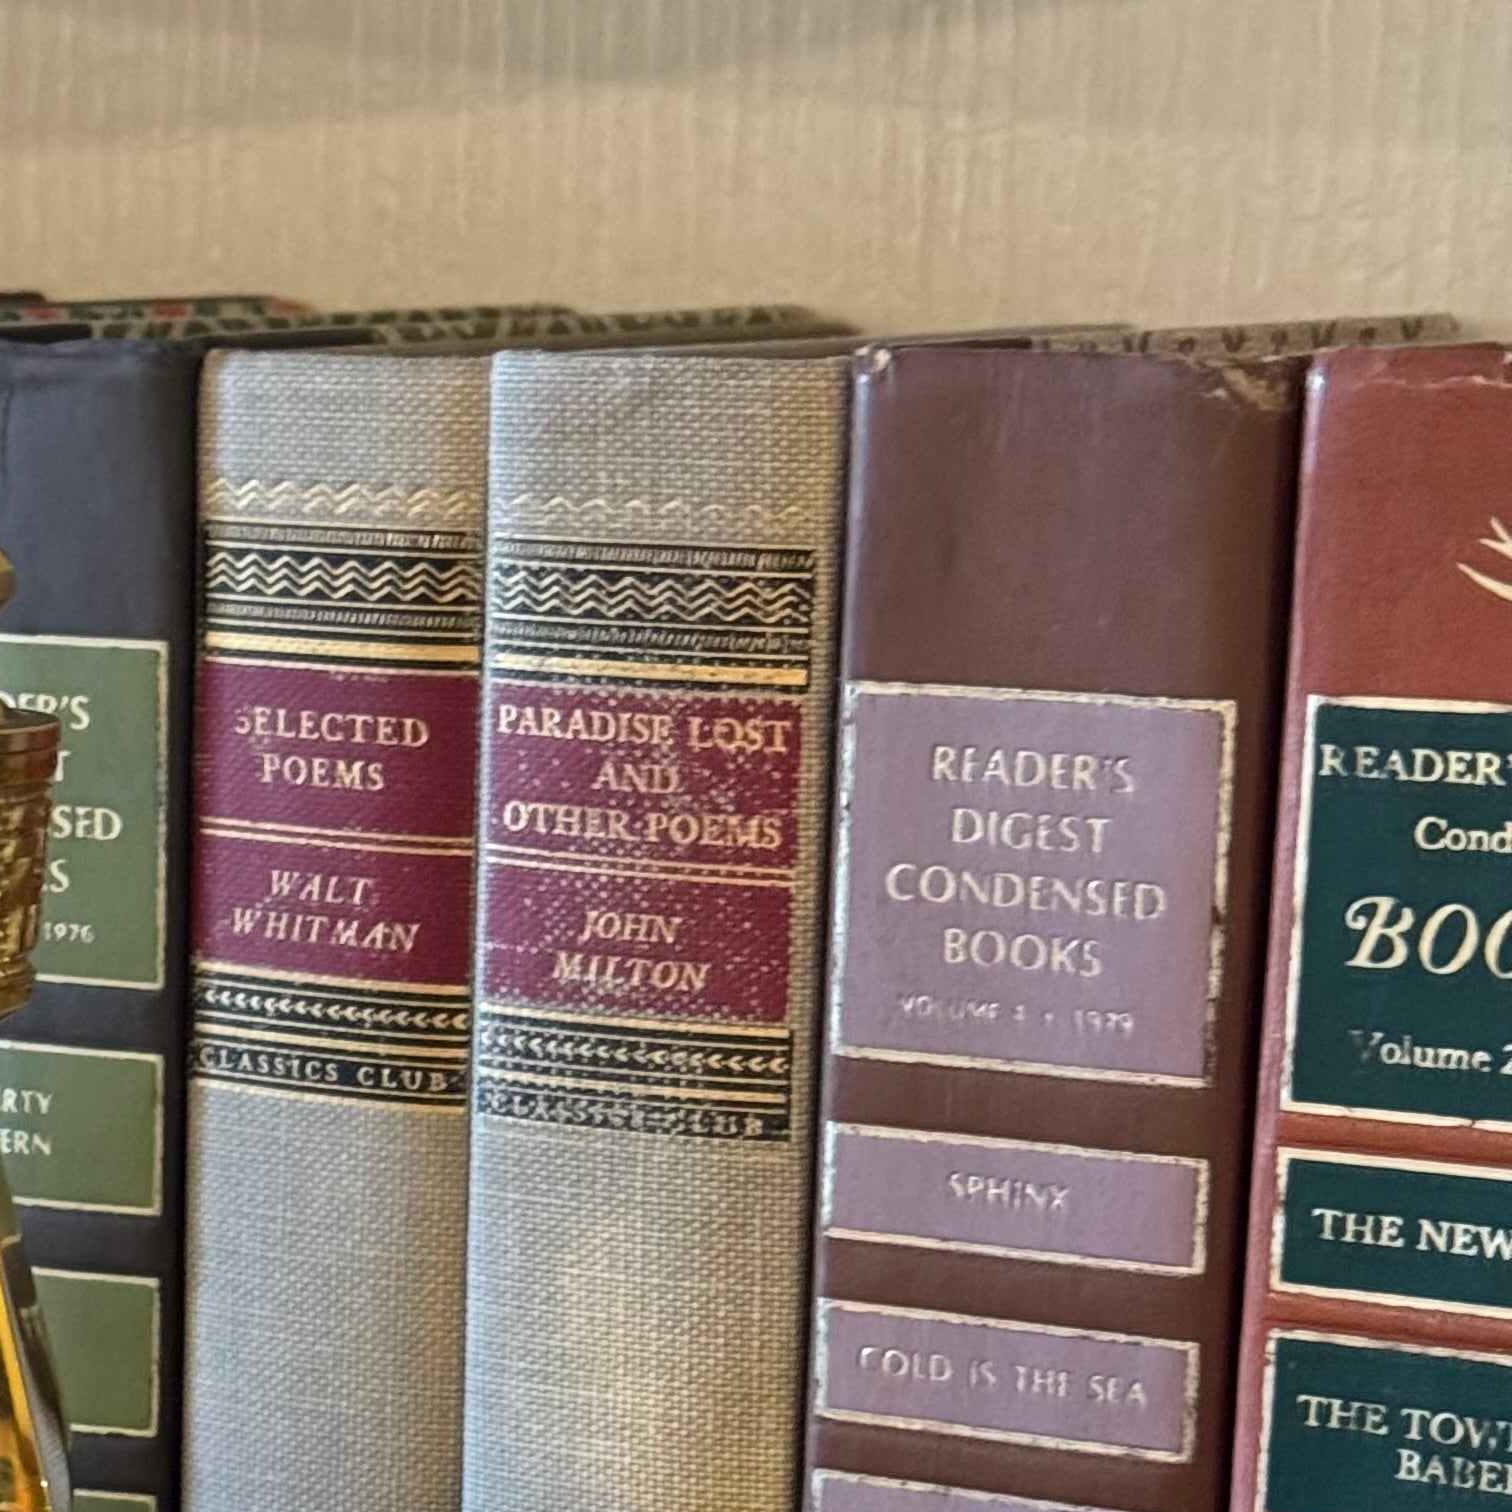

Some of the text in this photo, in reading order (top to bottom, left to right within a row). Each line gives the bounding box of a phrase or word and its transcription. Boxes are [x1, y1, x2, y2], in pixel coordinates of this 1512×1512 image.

[235, 706, 430, 750] SELECTED
[498, 703, 791, 753] PARADISE LOST
[261, 753, 385, 792] POEMS
[591, 763, 680, 796] AND
[931, 745, 1135, 794] READER'S
[502, 800, 785, 850] OTHER POEMS
[951, 808, 1112, 853] DIGEST
[270, 868, 374, 906] WALT
[885, 863, 1168, 921] CONDENSED
[42, 921, 95, 945] 1976
[231, 908, 421, 953] WHITMAN
[582, 910, 684, 944] JOHN
[554, 952, 712, 992] MILTON
[943, 928, 1103, 977] BOOKS
[199, 1047, 448, 1092] CLASSICS CLUB
[1348, 1030, 1492, 1072] Volume
[948, 1171, 1069, 1211] SPHINX
[1311, 1208, 1405, 1249] THE
[859, 1347, 1148, 1408] COLD IS THE SEA
[1296, 1394, 1389, 1436] THE
